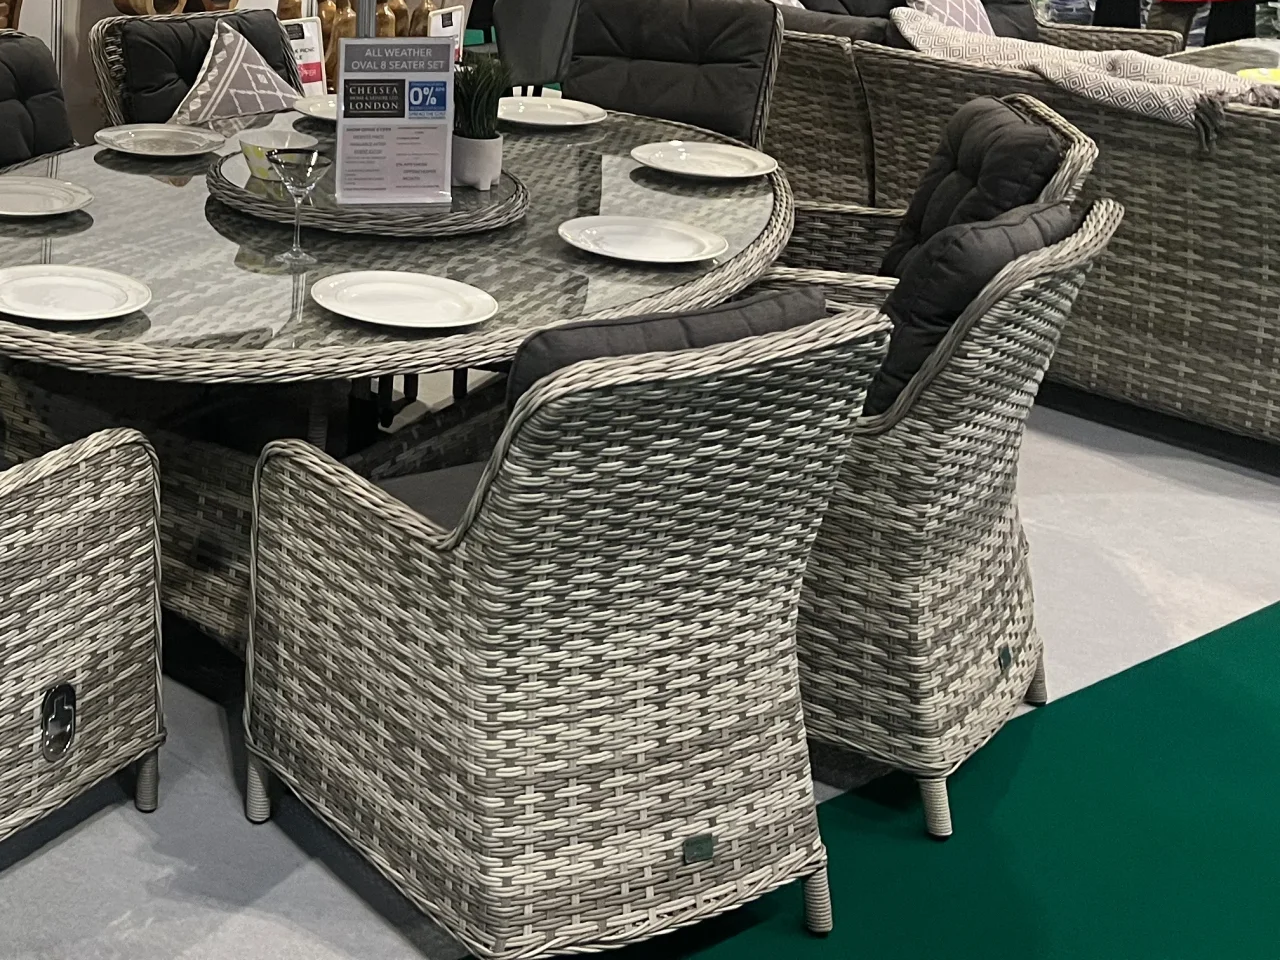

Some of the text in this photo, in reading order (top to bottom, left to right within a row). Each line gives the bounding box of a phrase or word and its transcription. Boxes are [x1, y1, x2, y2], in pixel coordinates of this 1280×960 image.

[365, 48, 432, 57] ALL WEATHER
[351, 60, 445, 70] OVAL 8 SEATER SET
[409, 87, 437, 105] 0%
[349, 102, 398, 110] LONDON
